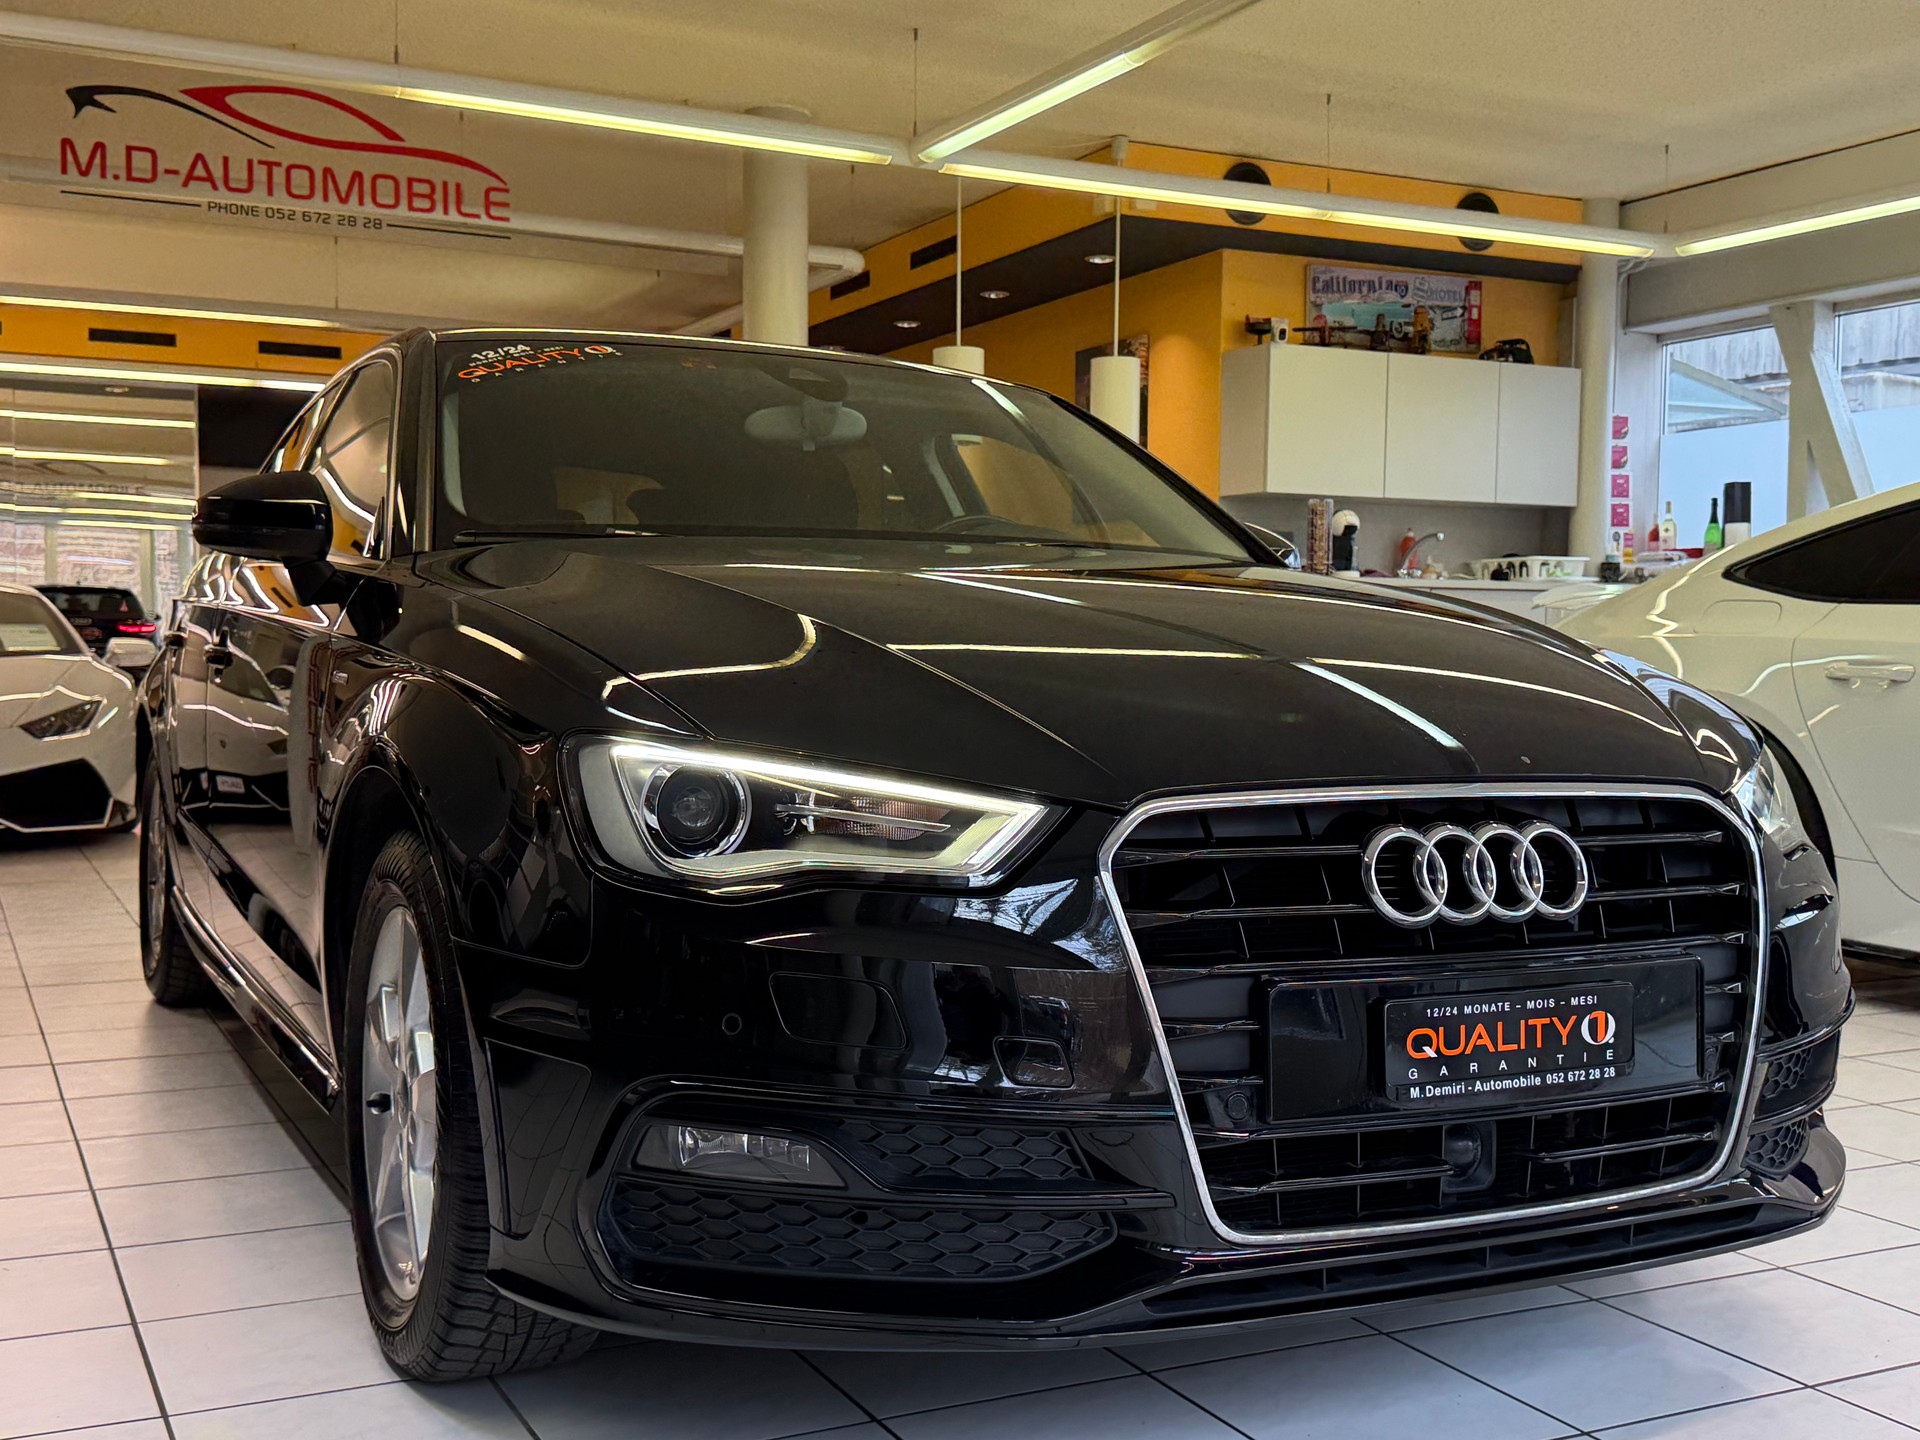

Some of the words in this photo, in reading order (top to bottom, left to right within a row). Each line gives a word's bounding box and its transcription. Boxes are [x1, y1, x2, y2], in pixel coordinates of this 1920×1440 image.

[60, 137, 511, 222] M.D-AUTOMOBILE
[207, 200, 260, 218] PHONE
[264, 206, 297, 222] 052
[301, 211, 332, 225] 672
[336, 213, 358, 228] 28
[362, 216, 384, 230] 28
[1311, 275, 1394, 295] California
[457, 348, 582, 379] QUALITY
[470, 344, 531, 360] 12/24
[1426, 1006, 1459, 1018] 12/24
[1463, 1002, 1511, 1015] MONATE
[1526, 998, 1556, 1010] MOIS
[1570, 995, 1598, 1006] MESI
[1406, 1015, 1578, 1060] QUALITY
[1407, 1049, 1614, 1080] GARANTIE
[1546, 1072, 1565, 1084] 052
[1567, 1070, 1586, 1082] 672
[1588, 1068, 1601, 1080] 28
[1603, 1066, 1616, 1078] 28
